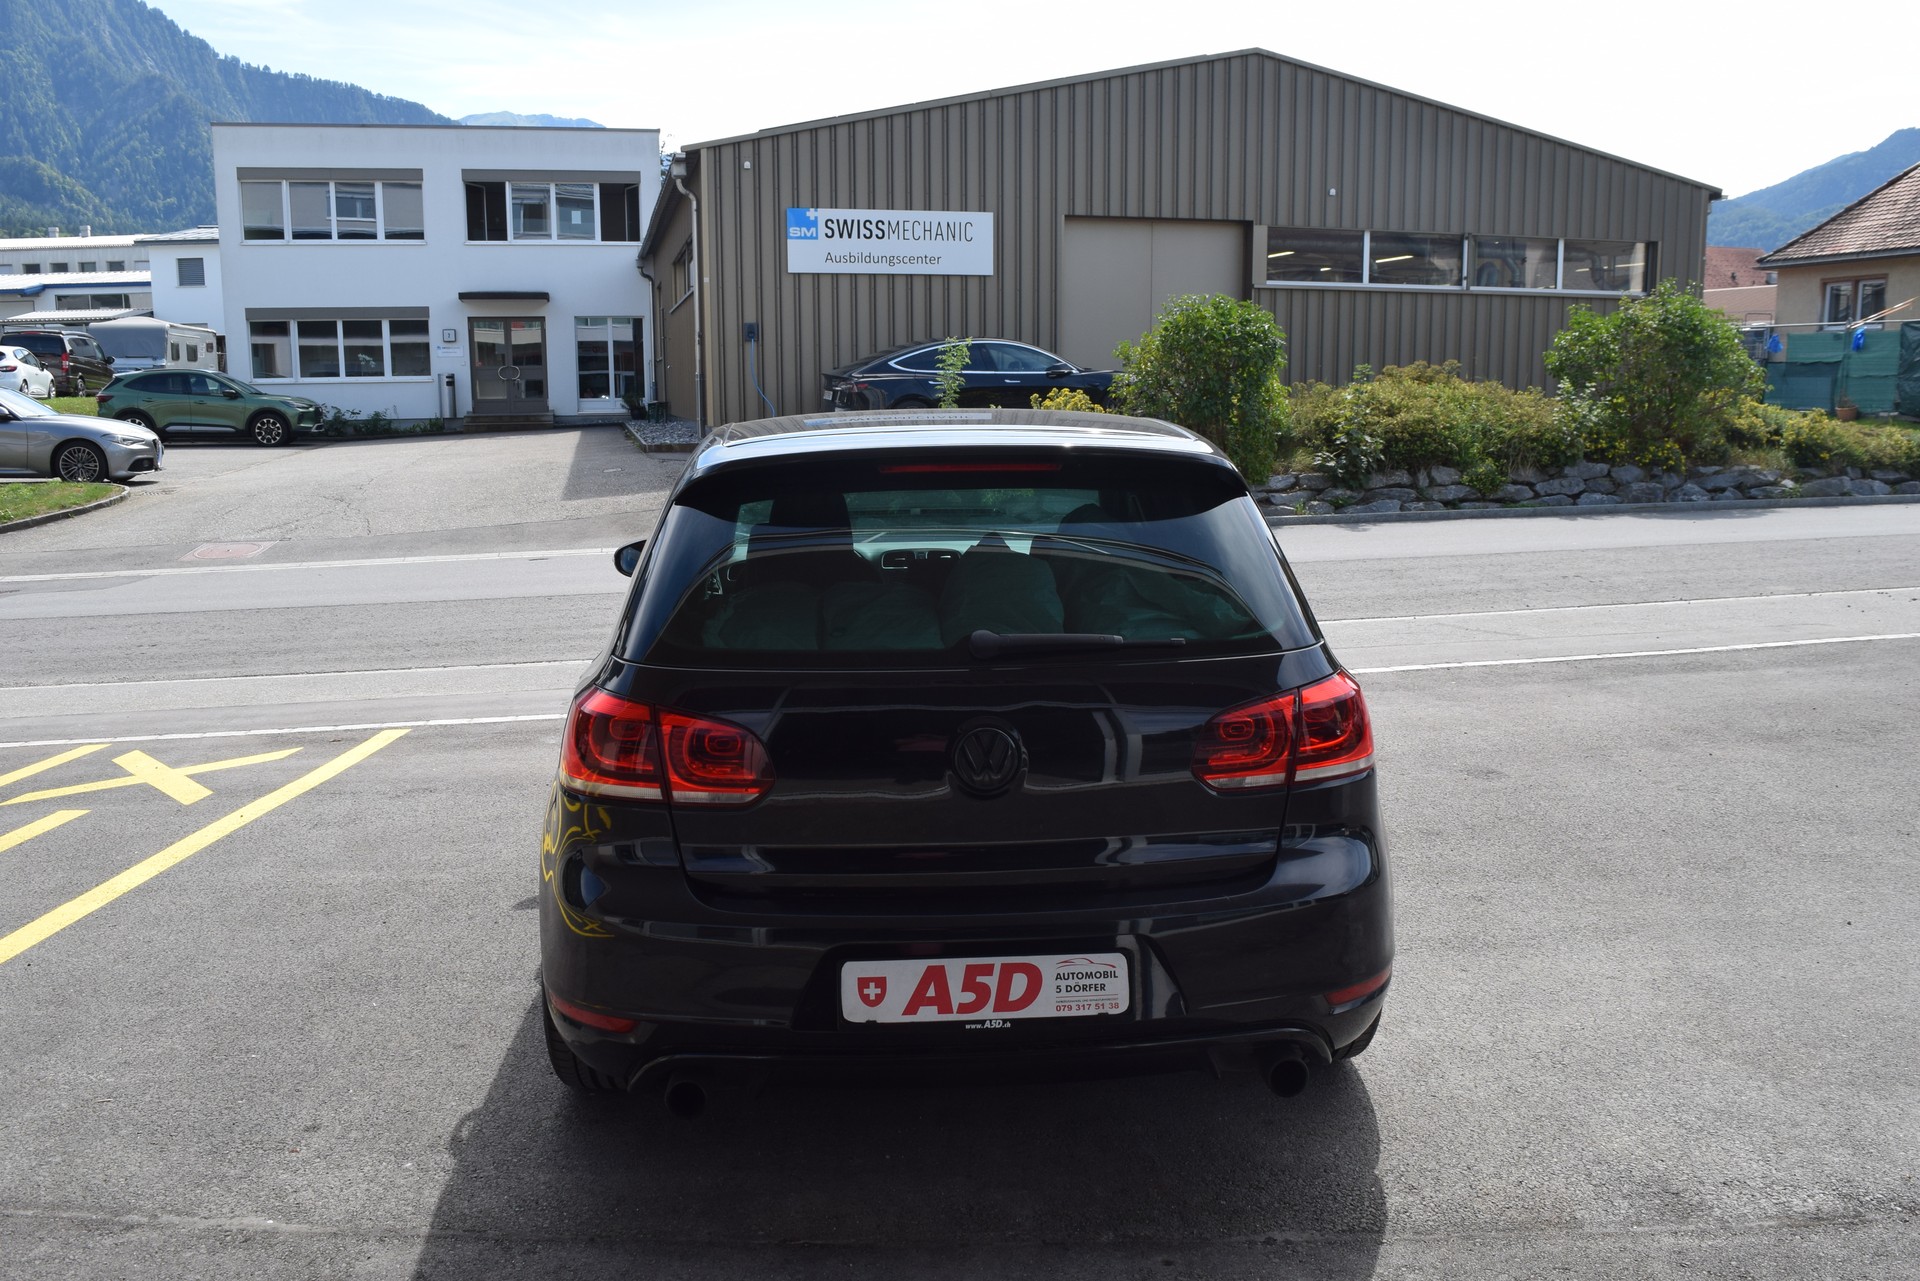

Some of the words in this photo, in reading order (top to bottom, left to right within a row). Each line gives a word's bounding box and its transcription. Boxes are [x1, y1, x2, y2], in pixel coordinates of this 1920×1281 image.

[789, 227, 817, 237] SM
[824, 218, 973, 242] SWISSMECHANIC
[824, 251, 942, 267] Ausbildungscenter
[1055, 970, 1118, 981] AUTOMOBIL
[901, 962, 1043, 1016] A5D
[1056, 985, 1062, 994] 5
[1065, 982, 1106, 993] DÖRFER
[1055, 1004, 1073, 1012] 079
[1075, 1003, 1092, 1011] 317
[1094, 1002, 1105, 1010] 51
[965, 1019, 1011, 1029] www.A5D.ch
